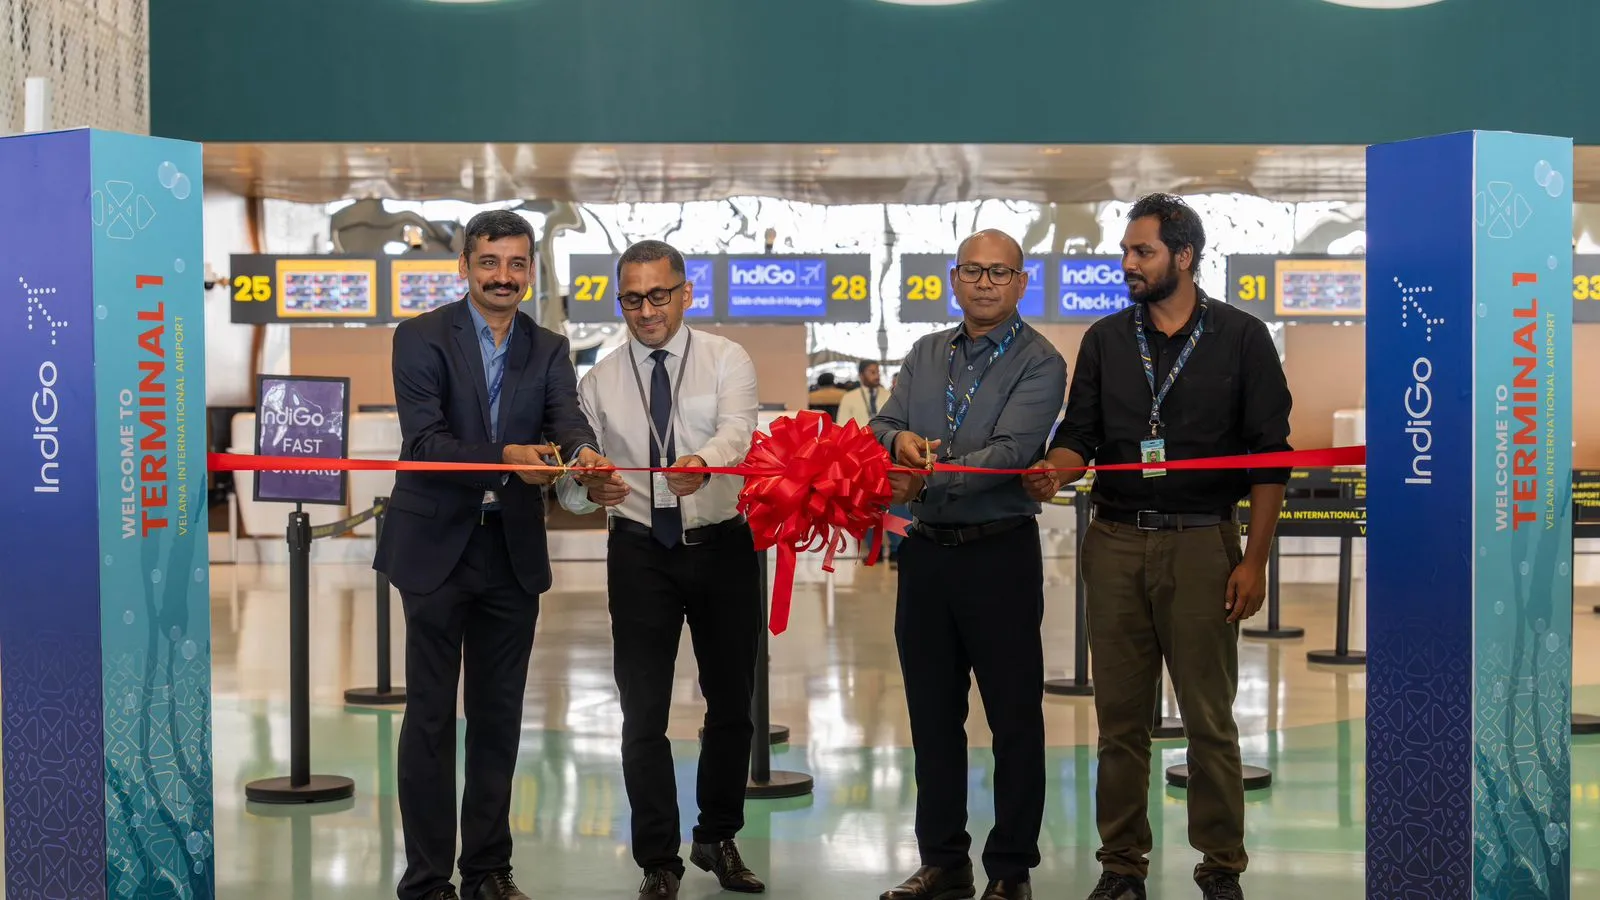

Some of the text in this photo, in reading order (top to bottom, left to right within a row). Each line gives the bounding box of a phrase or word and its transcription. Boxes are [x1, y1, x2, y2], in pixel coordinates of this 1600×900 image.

[731, 264, 796, 285] IndiGo
[1062, 264, 1125, 285] IndiGo
[1573, 275, 1600, 300] 33
[233, 275, 272, 302] 25
[574, 275, 609, 301] 27
[831, 275, 867, 301] 28
[906, 275, 943, 301] 29
[1062, 292, 1129, 310] Check-in
[1238, 275, 1266, 301] 31
[135, 274, 168, 538] TERMINAL 1
[1512, 272, 1538, 531] TERMINAL 1
[32, 361, 59, 492] IndiGo
[174, 315, 188, 537] VELANA INTERNATIONAL AIRPORT
[260, 406, 324, 427] IndiGo
[1404, 357, 1432, 484] IndiGo
[1546, 311, 1555, 530] VELANA INTERNATIONAL AIRPORT
[282, 438, 323, 454] FAST
[1495, 384, 1508, 532] WELCOME TO
[119, 388, 136, 540] WELCOME TO
[1293, 510, 1360, 519] INTERNATIONAL
